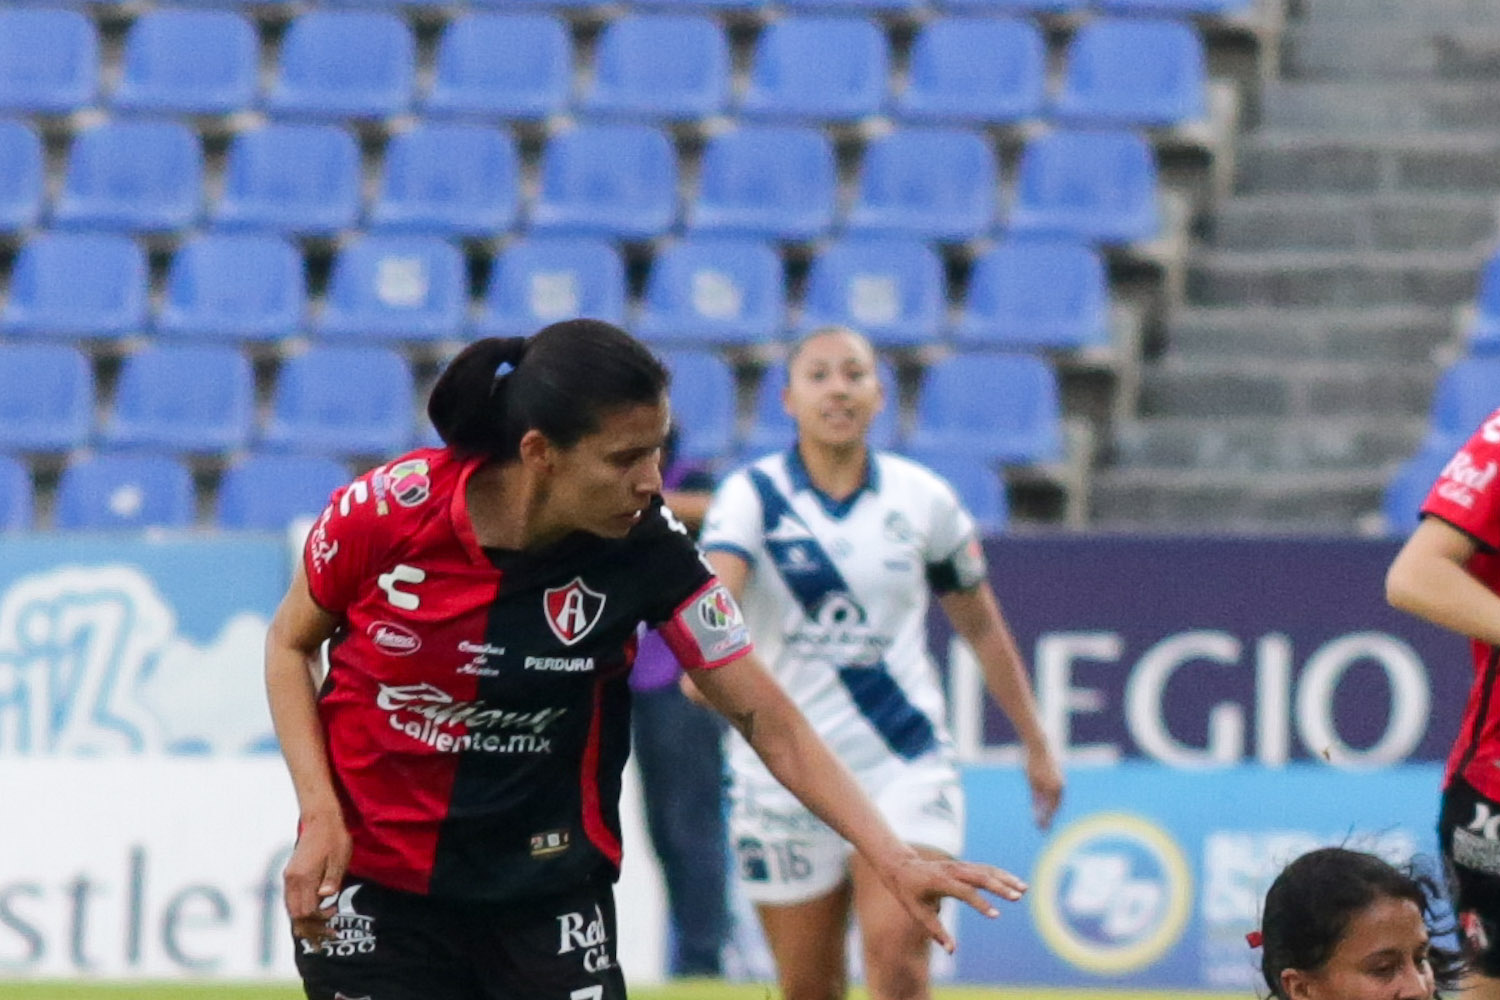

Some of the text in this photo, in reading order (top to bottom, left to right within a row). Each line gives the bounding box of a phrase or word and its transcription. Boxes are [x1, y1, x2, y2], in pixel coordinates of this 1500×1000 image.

[524, 656, 595, 672] PERDURA
[389, 713, 552, 753] caliente.mx
[556, 903, 608, 955] Red
